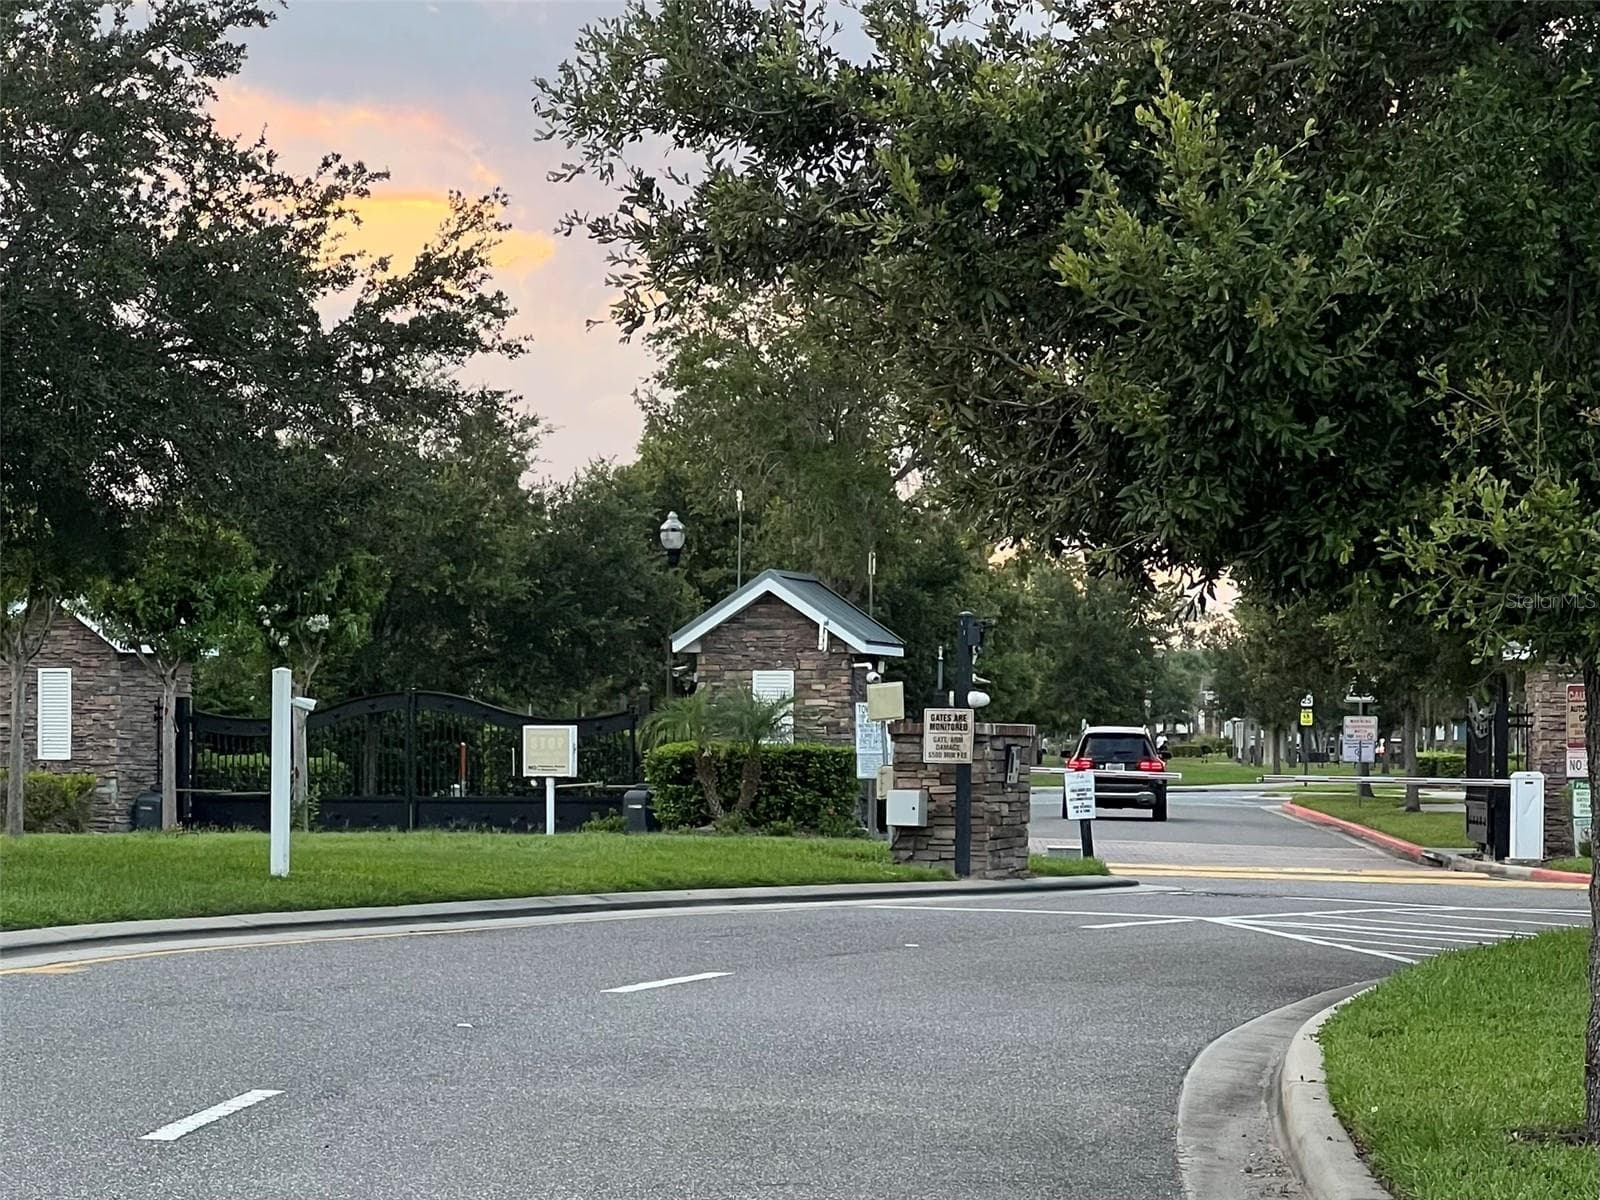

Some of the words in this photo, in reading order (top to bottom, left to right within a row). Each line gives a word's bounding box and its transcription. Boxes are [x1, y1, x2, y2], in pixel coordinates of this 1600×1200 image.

[1568, 690, 1586, 701] CAU
[930, 713, 952, 722] GATES
[953, 714, 967, 722] ARE
[929, 723, 968, 731] MONITORED
[529, 736, 564, 749] STOP
[1569, 759, 1582, 771] NO
